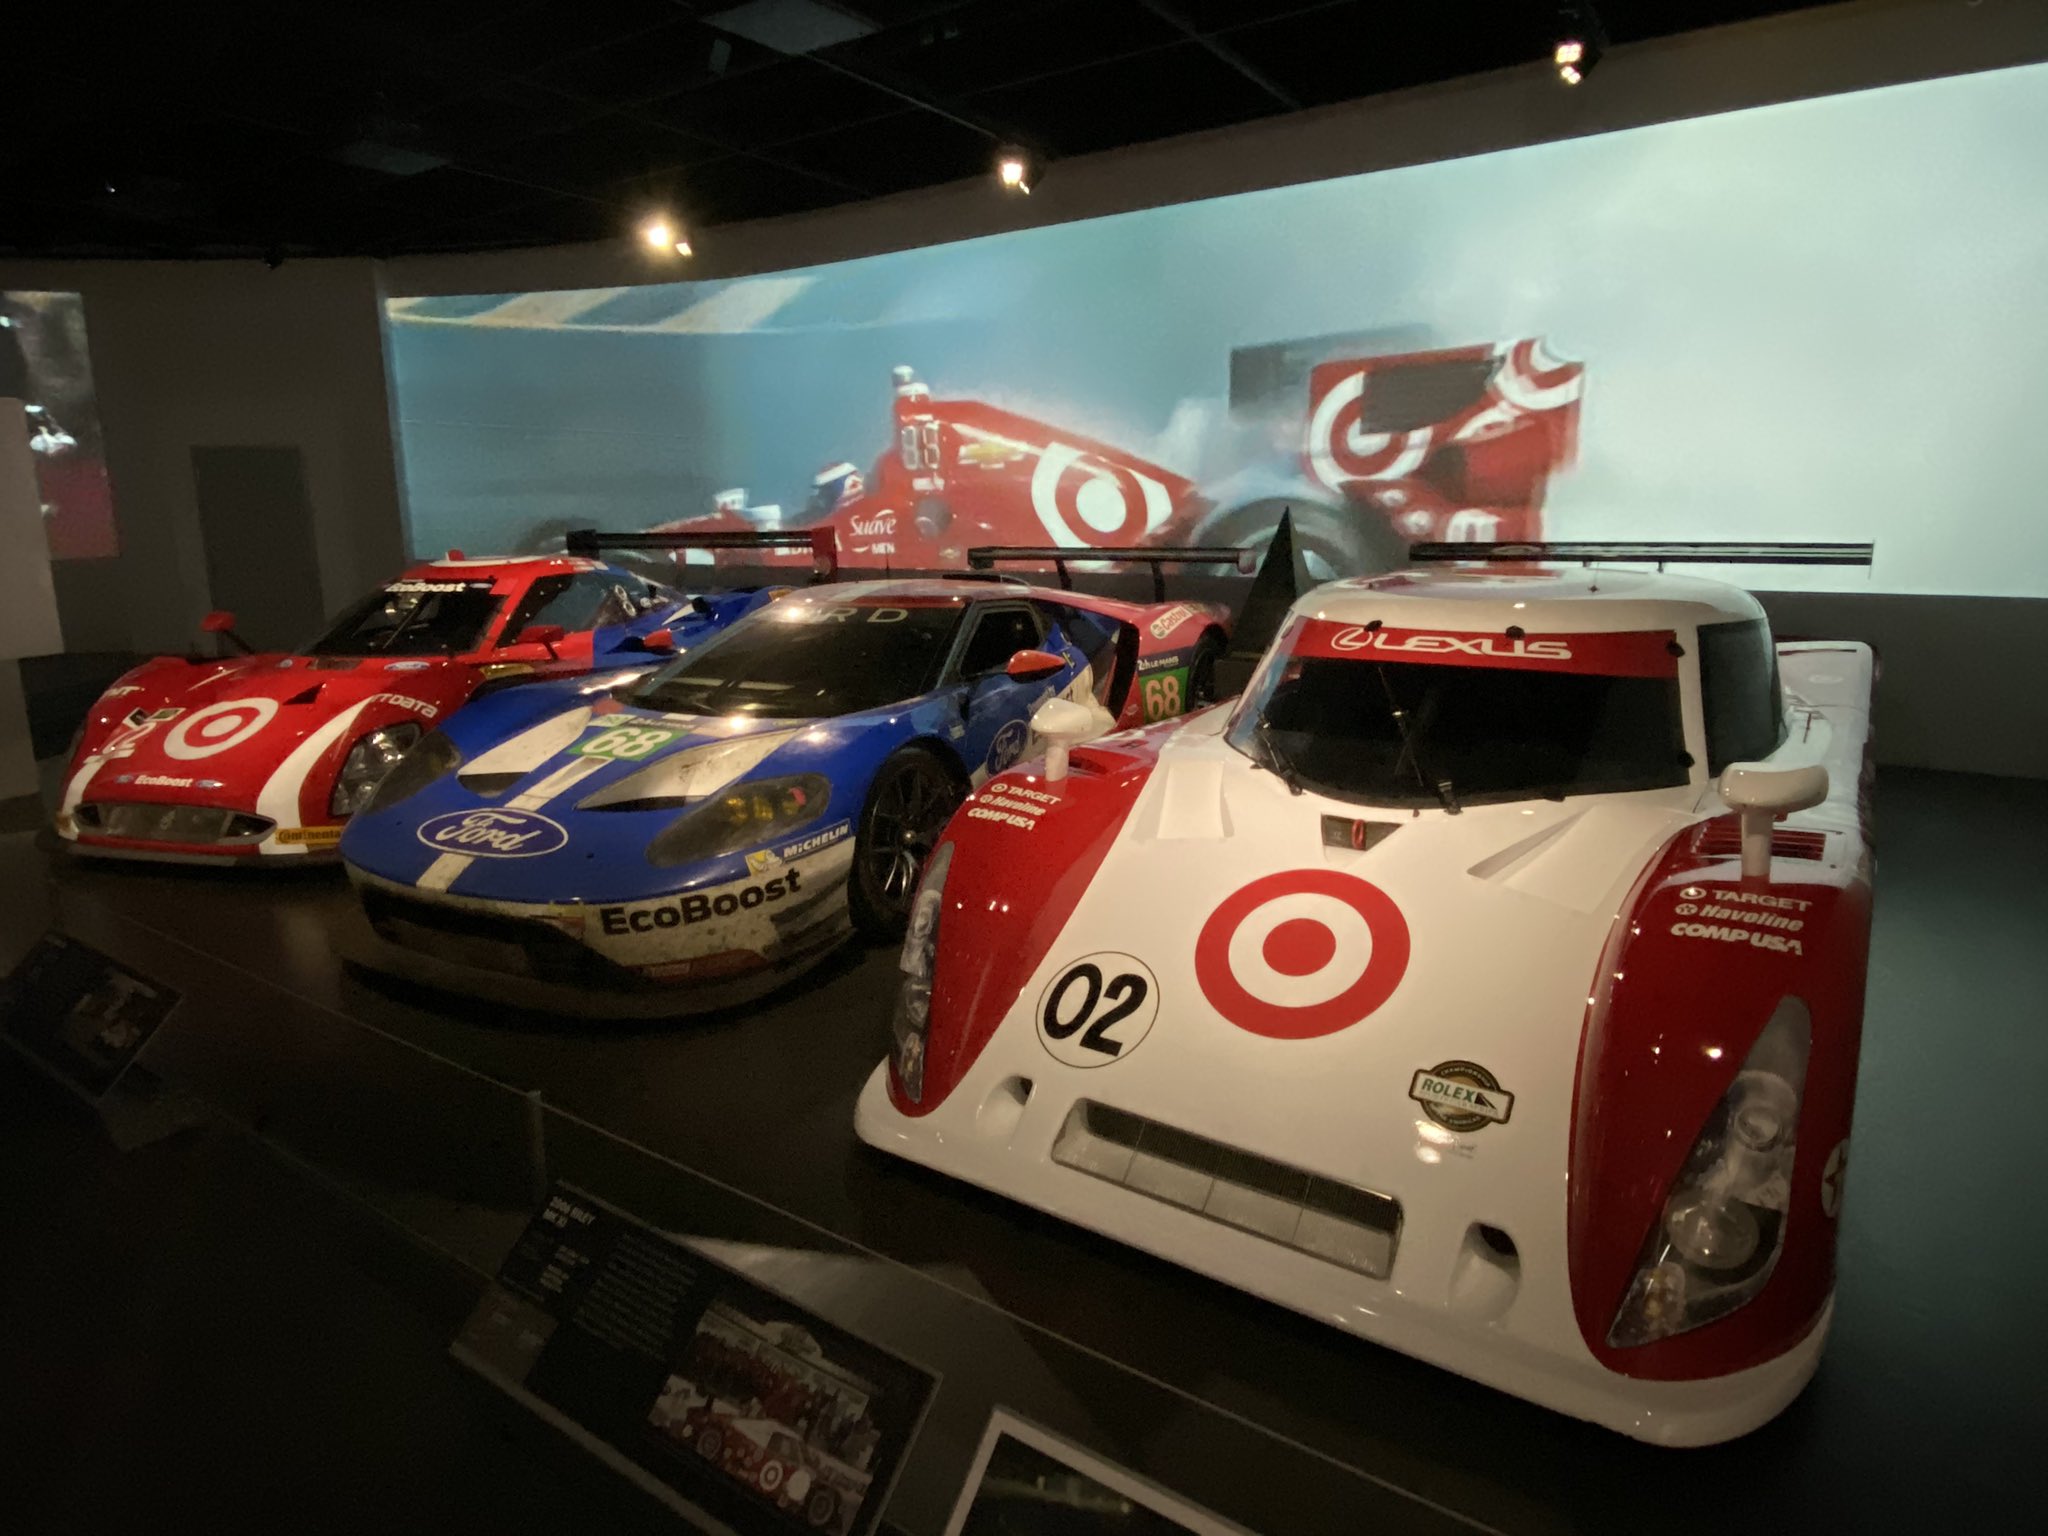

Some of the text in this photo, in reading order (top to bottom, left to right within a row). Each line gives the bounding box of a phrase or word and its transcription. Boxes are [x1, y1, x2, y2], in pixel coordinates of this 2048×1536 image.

[849, 510, 897, 536] Suave
[1374, 632, 1573, 660] LEXUS
[1145, 675, 1182, 721] 68
[581, 727, 673, 757] 68
[994, 728, 1021, 772] Ford
[133, 774, 194, 788] EcoBoost
[1007, 785, 1062, 805] TARGET
[989, 796, 1047, 816] Havoline
[435, 812, 543, 852] Ford
[782, 823, 851, 860] MICHELIN
[599, 867, 803, 936] EcoBoost
[1712, 888, 1814, 912] TARGET
[1698, 903, 1805, 932] Havoline
[1043, 962, 1148, 1057] 02
[1420, 1077, 1476, 1103] ROLEX
